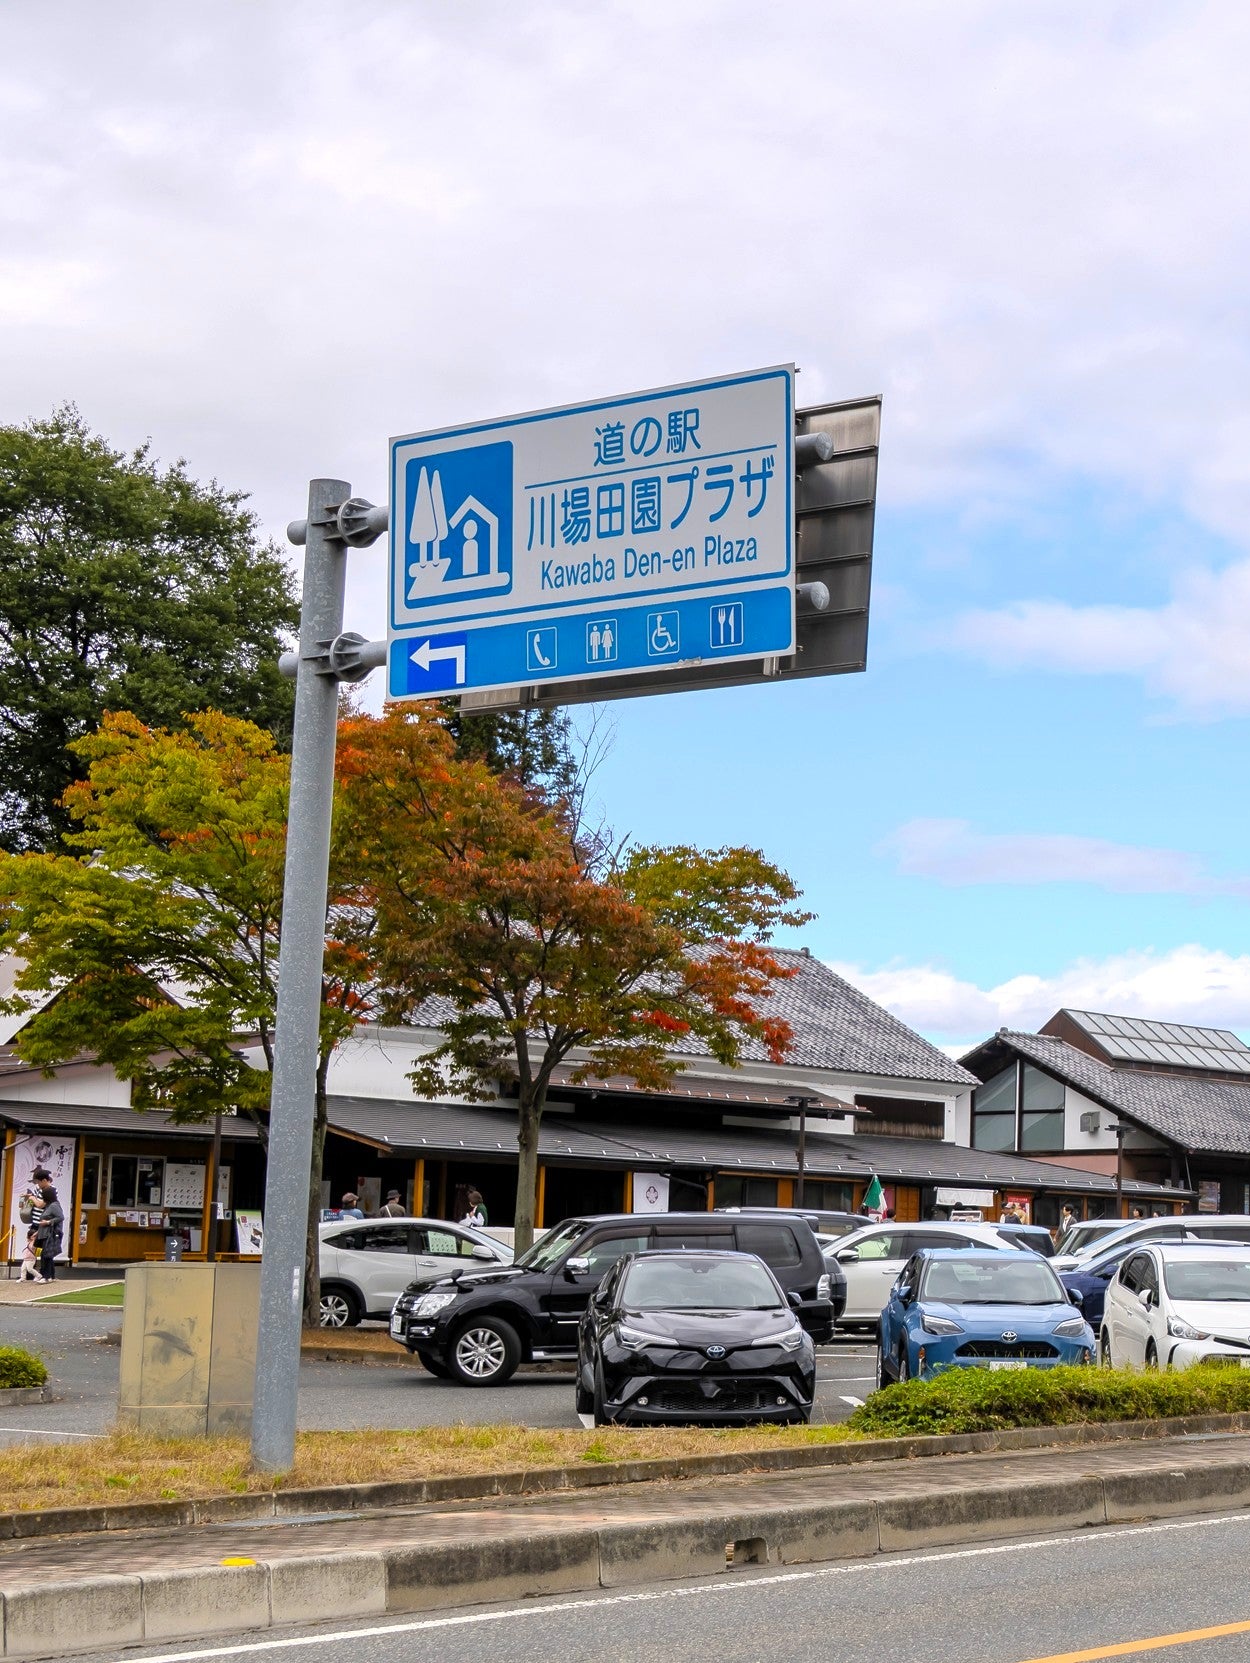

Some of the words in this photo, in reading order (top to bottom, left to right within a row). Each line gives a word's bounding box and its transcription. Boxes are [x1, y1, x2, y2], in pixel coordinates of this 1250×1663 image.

[593, 407, 702, 467] 道の駅
[526, 454, 775, 551] 川場田園プラザ
[540, 555, 616, 589] Kawaba
[623, 547, 696, 579] Den-en
[703, 535, 758, 567] Plaza
